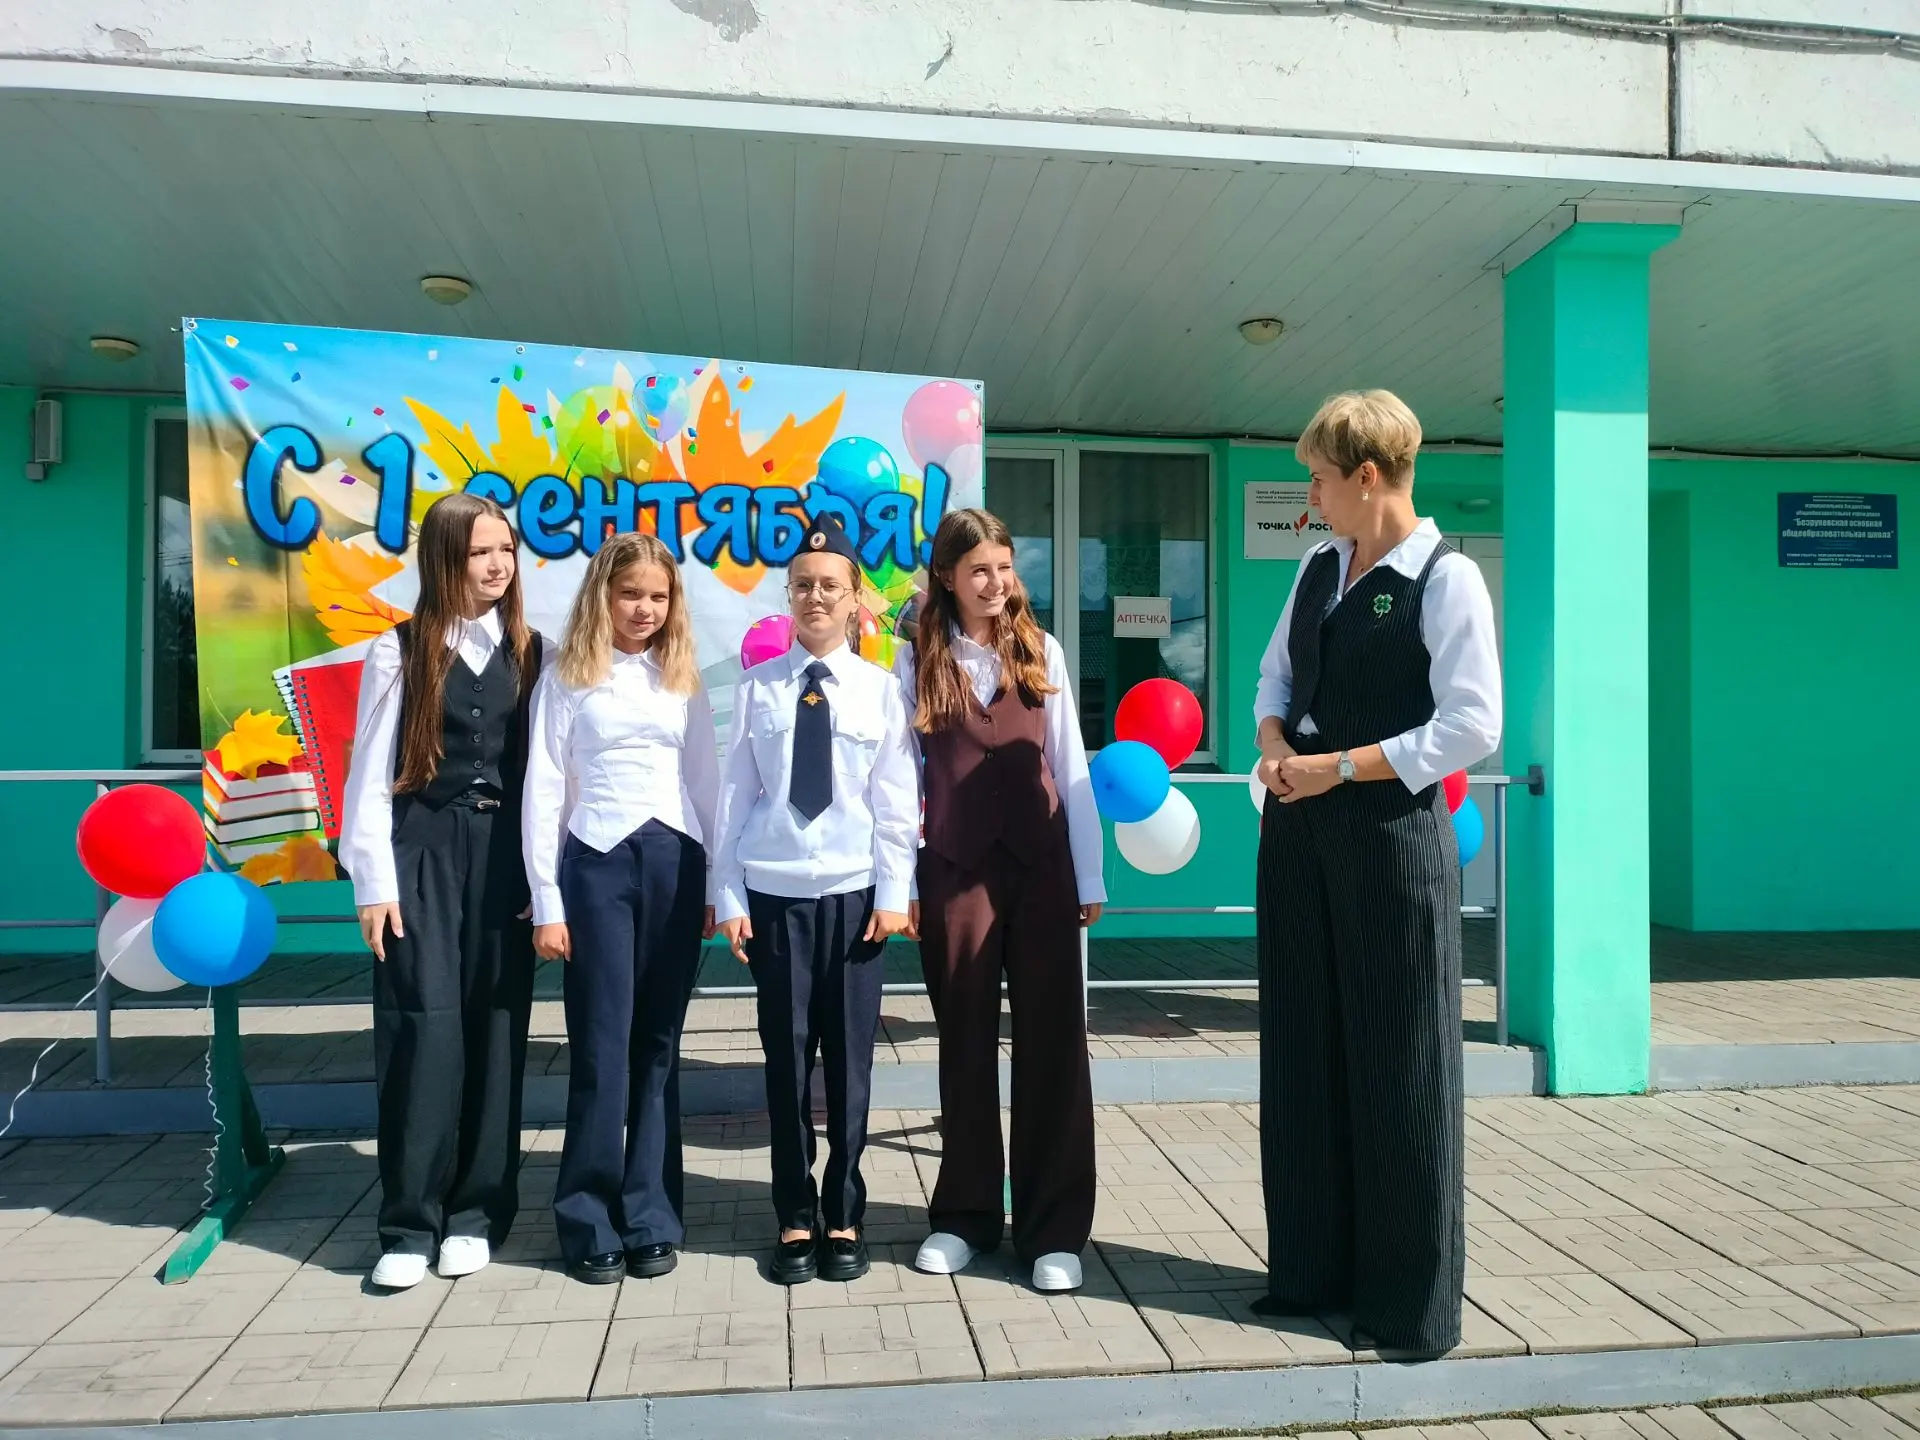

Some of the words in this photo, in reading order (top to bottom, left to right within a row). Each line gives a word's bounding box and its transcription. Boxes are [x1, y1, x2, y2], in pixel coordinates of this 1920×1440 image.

[244, 423, 324, 551] С
[361, 430, 415, 554] 1
[1257, 522, 1291, 531] ТОЧКА
[1116, 614, 1168, 624] АПТЕЧКА
